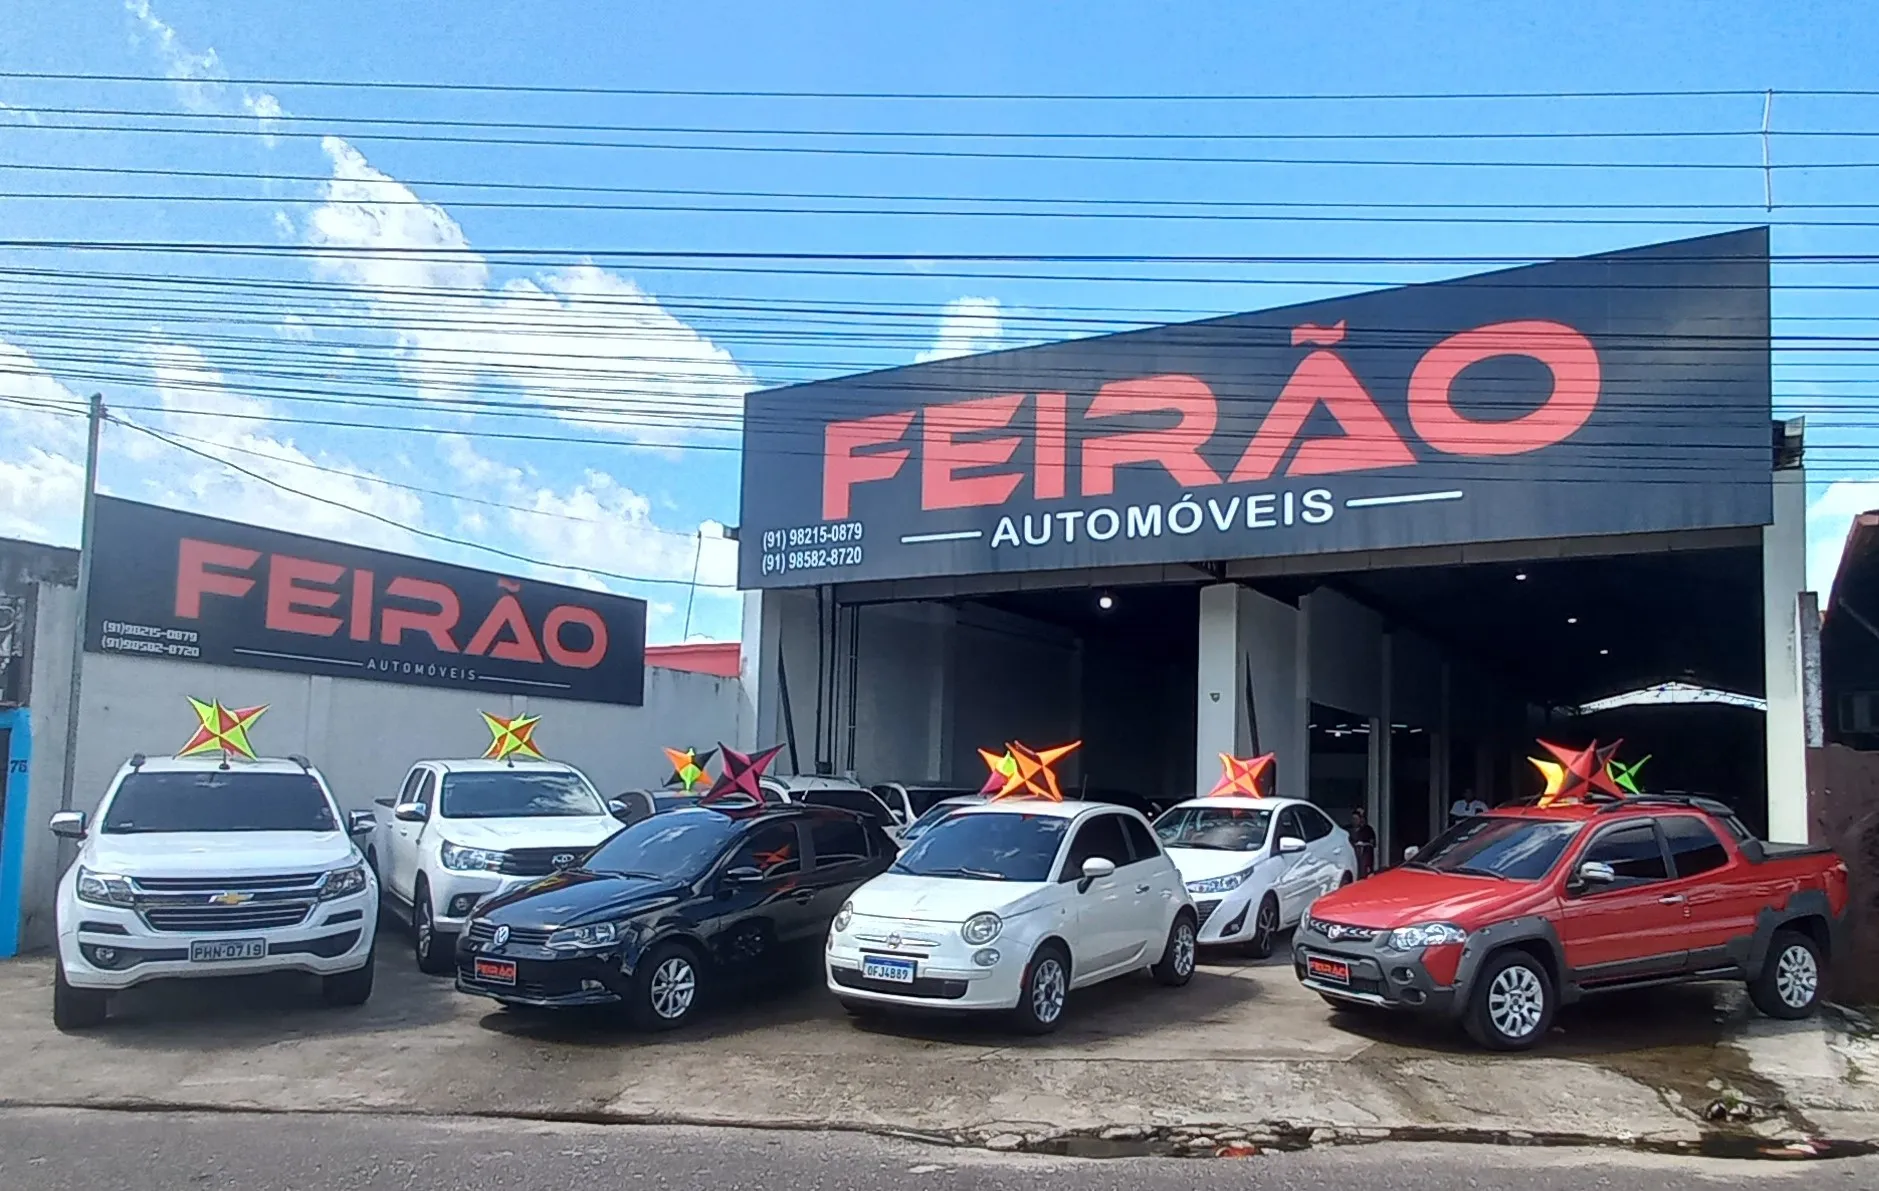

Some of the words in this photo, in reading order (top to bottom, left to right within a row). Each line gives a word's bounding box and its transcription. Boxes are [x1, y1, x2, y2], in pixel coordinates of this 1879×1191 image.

[822, 319, 1600, 520] FEIRÃO
[763, 530, 787, 552] (91)
[789, 522, 862, 547] 98215-0879
[991, 489, 1334, 548] AUTOMÓVEIS
[762, 553, 786, 576] (91)
[788, 546, 862, 570] 98582-8720
[175, 537, 609, 669] FEIRÃO
[367, 658, 477, 681] AUTOMÓVEIS
